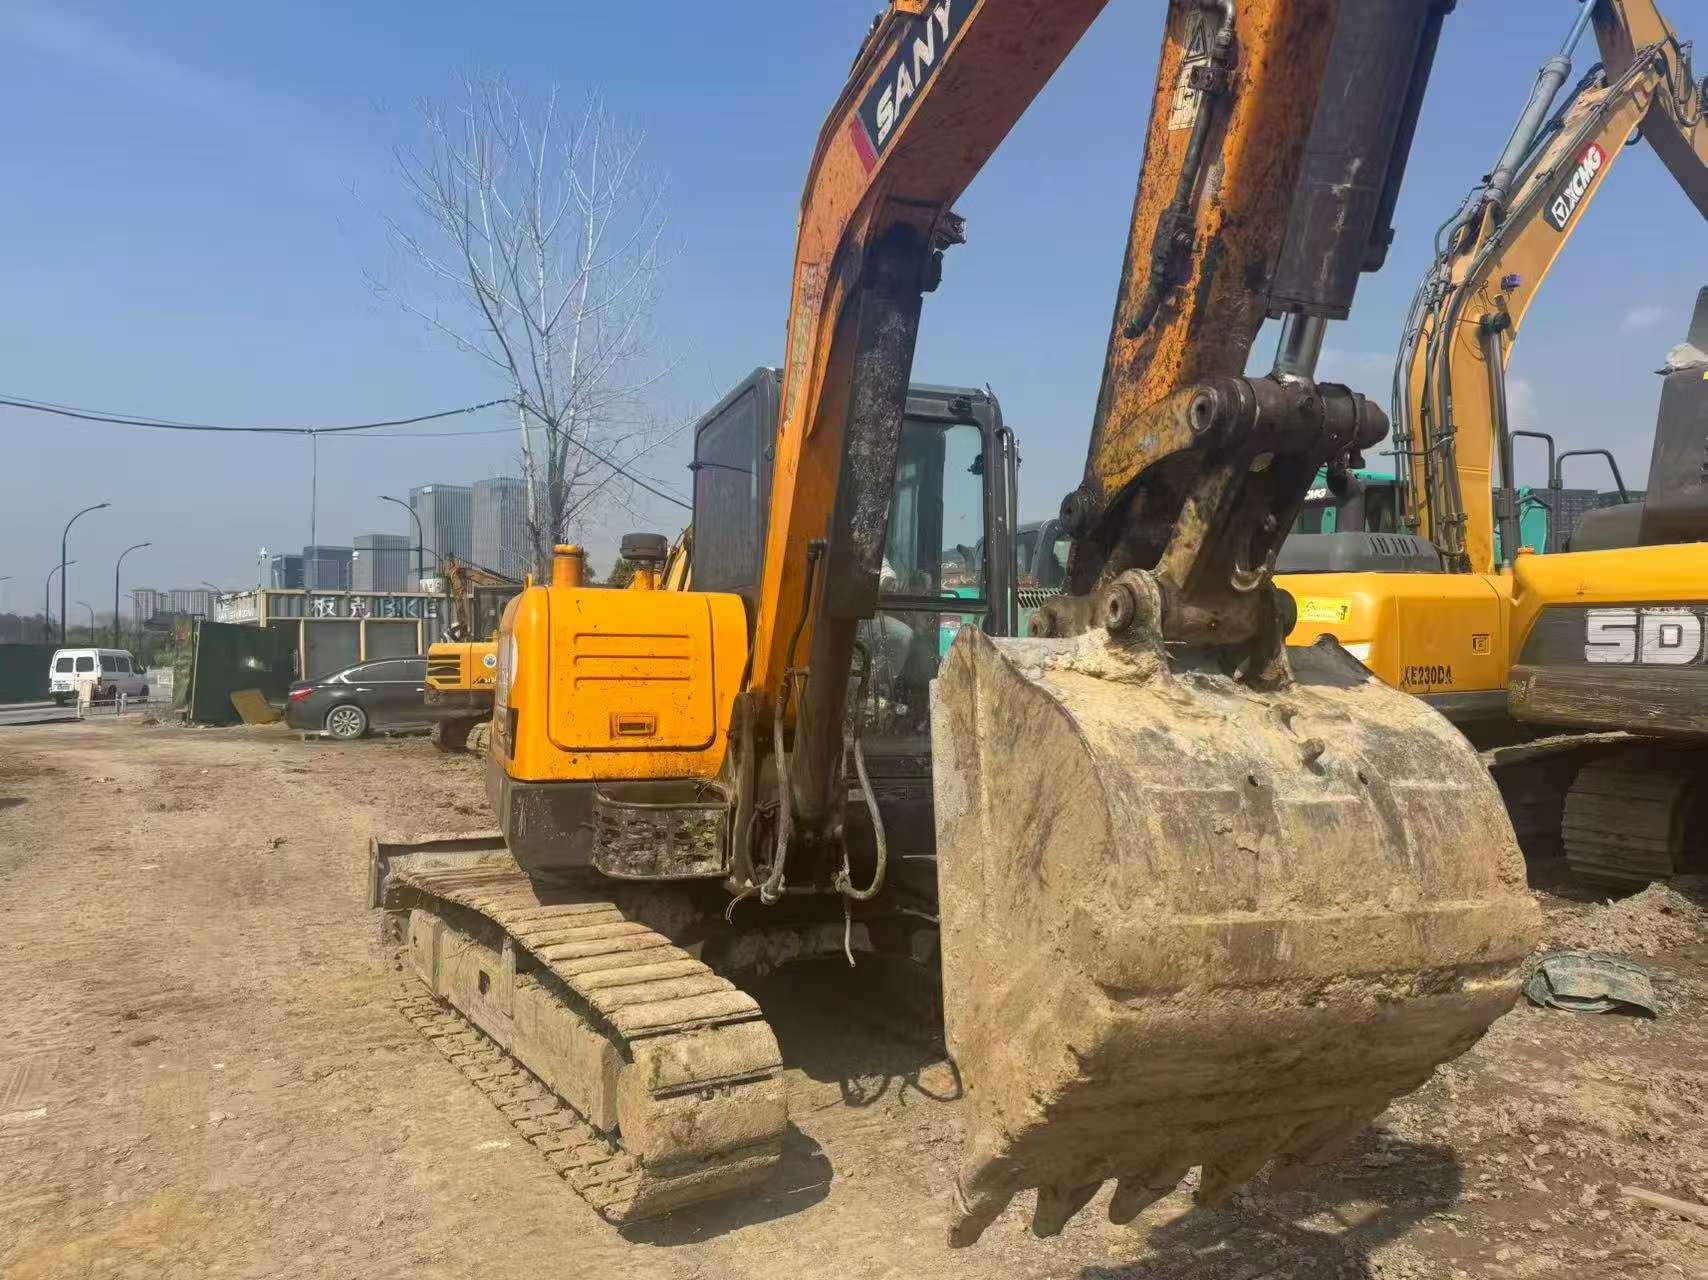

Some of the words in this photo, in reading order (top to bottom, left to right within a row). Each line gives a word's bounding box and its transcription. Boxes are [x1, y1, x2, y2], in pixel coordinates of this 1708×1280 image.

[876, 0, 951, 146] SANY
[1563, 146, 1602, 212] XCMG
[1584, 607, 1708, 665] SD
